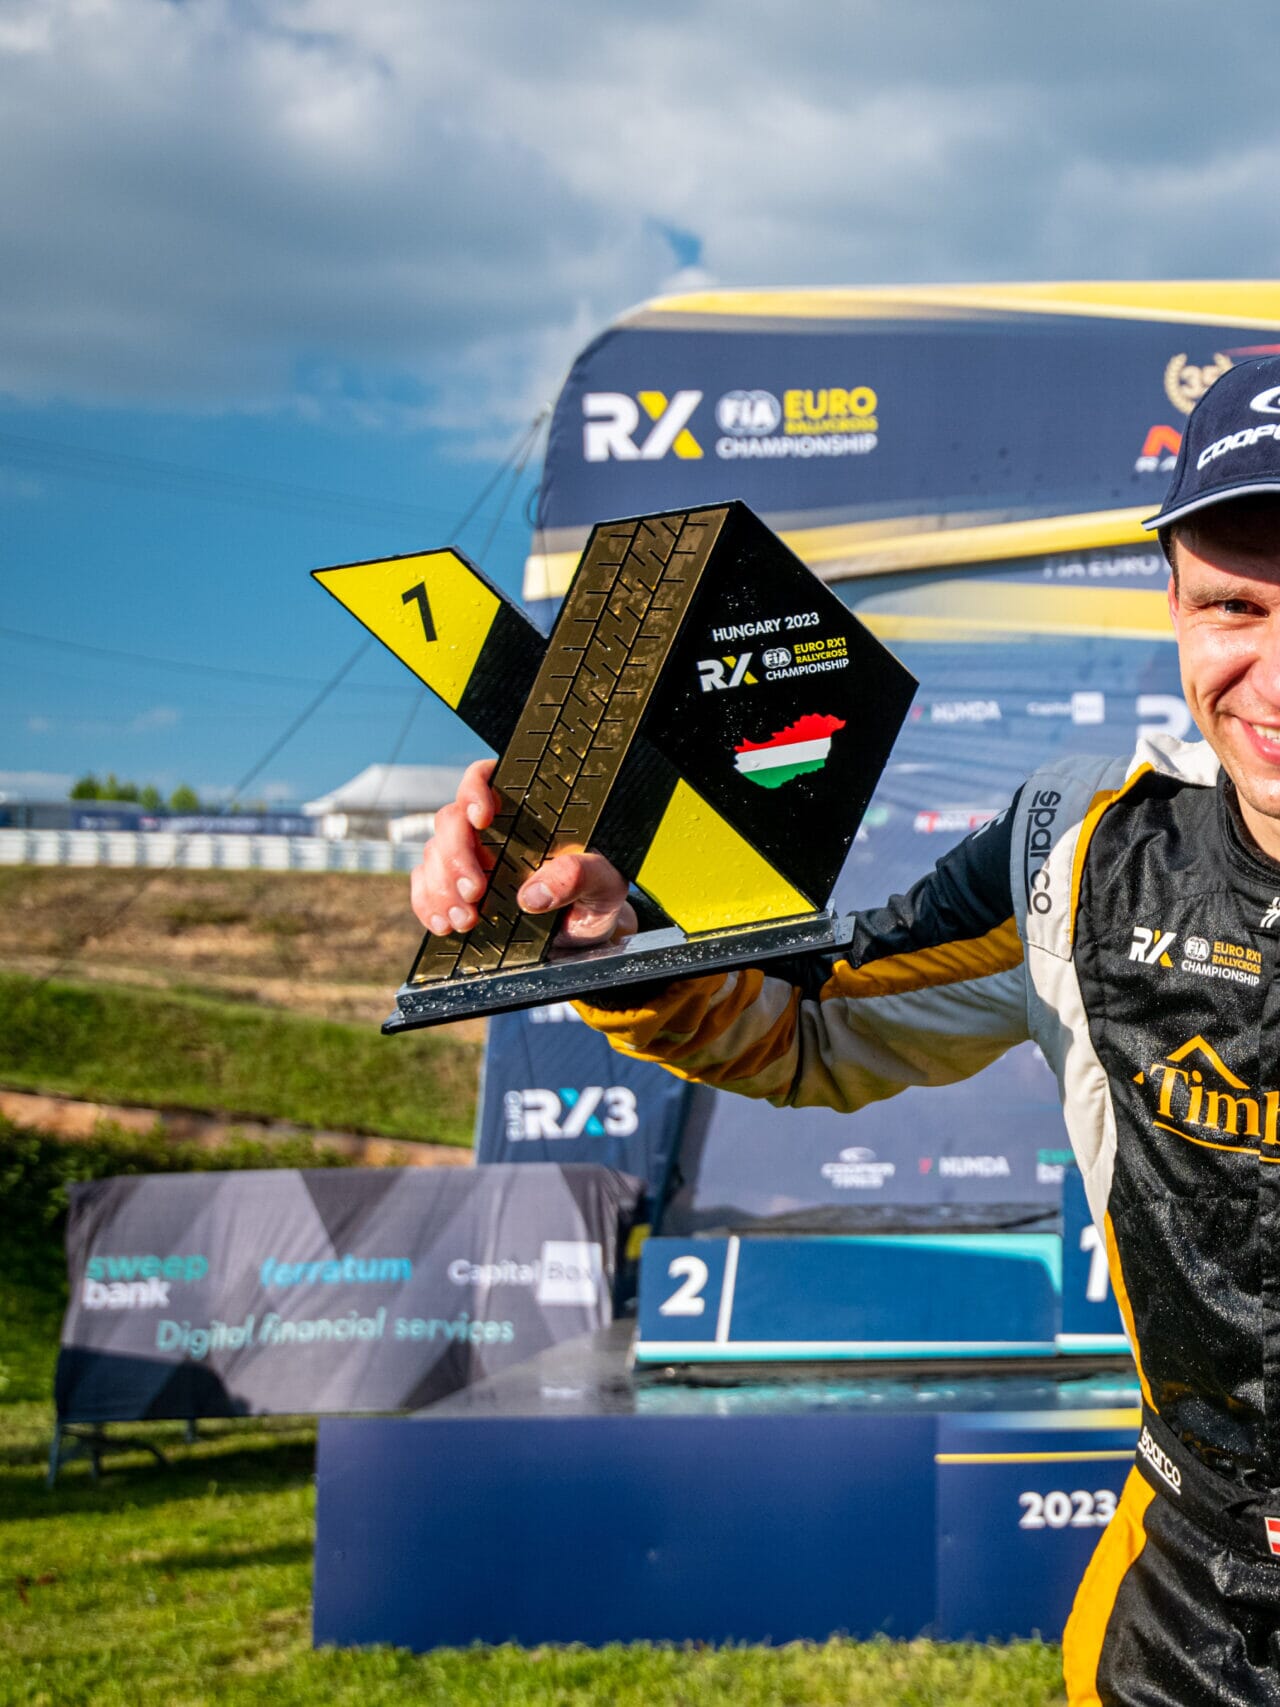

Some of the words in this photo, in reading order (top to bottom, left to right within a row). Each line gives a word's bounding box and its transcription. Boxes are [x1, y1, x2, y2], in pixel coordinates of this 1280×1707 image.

[582, 390, 704, 462] RX
[717, 396, 778, 431] FIA
[784, 386, 877, 418] EURO
[715, 433, 878, 459] CHAMPIONSHIP
[401, 581, 438, 642] 1
[712, 618, 781, 642] HUNGARY
[785, 612, 820, 630] 2023
[793, 641, 825, 655] EURO
[827, 637, 847, 649] RX1
[795, 648, 848, 664] RALLYCROSS
[696, 652, 759, 693] RX
[765, 658, 850, 681] CHAMPIONSHIP
[1024, 790, 1062, 915] sparco
[1129, 926, 1177, 968] RX
[1185, 937, 1210, 960] FIA
[1213, 941, 1244, 958] EURO
[1246, 948, 1262, 963] RX1
[1212, 954, 1261, 974] RALLYCROSS
[1181, 960, 1260, 986] CHAMPIONSHIP
[522, 1086, 639, 1140] RX3
[87, 1254, 208, 1282] sweep
[1081, 1223, 1109, 1302] 1
[83, 1277, 170, 1308] bank
[659, 1255, 708, 1316] 2
[155, 1314, 255, 1358] Digital
[258, 1307, 388, 1345] financial
[394, 1311, 515, 1344] services
[1137, 1426, 1182, 1495] sparco
[1019, 1490, 1118, 1529] 2023
